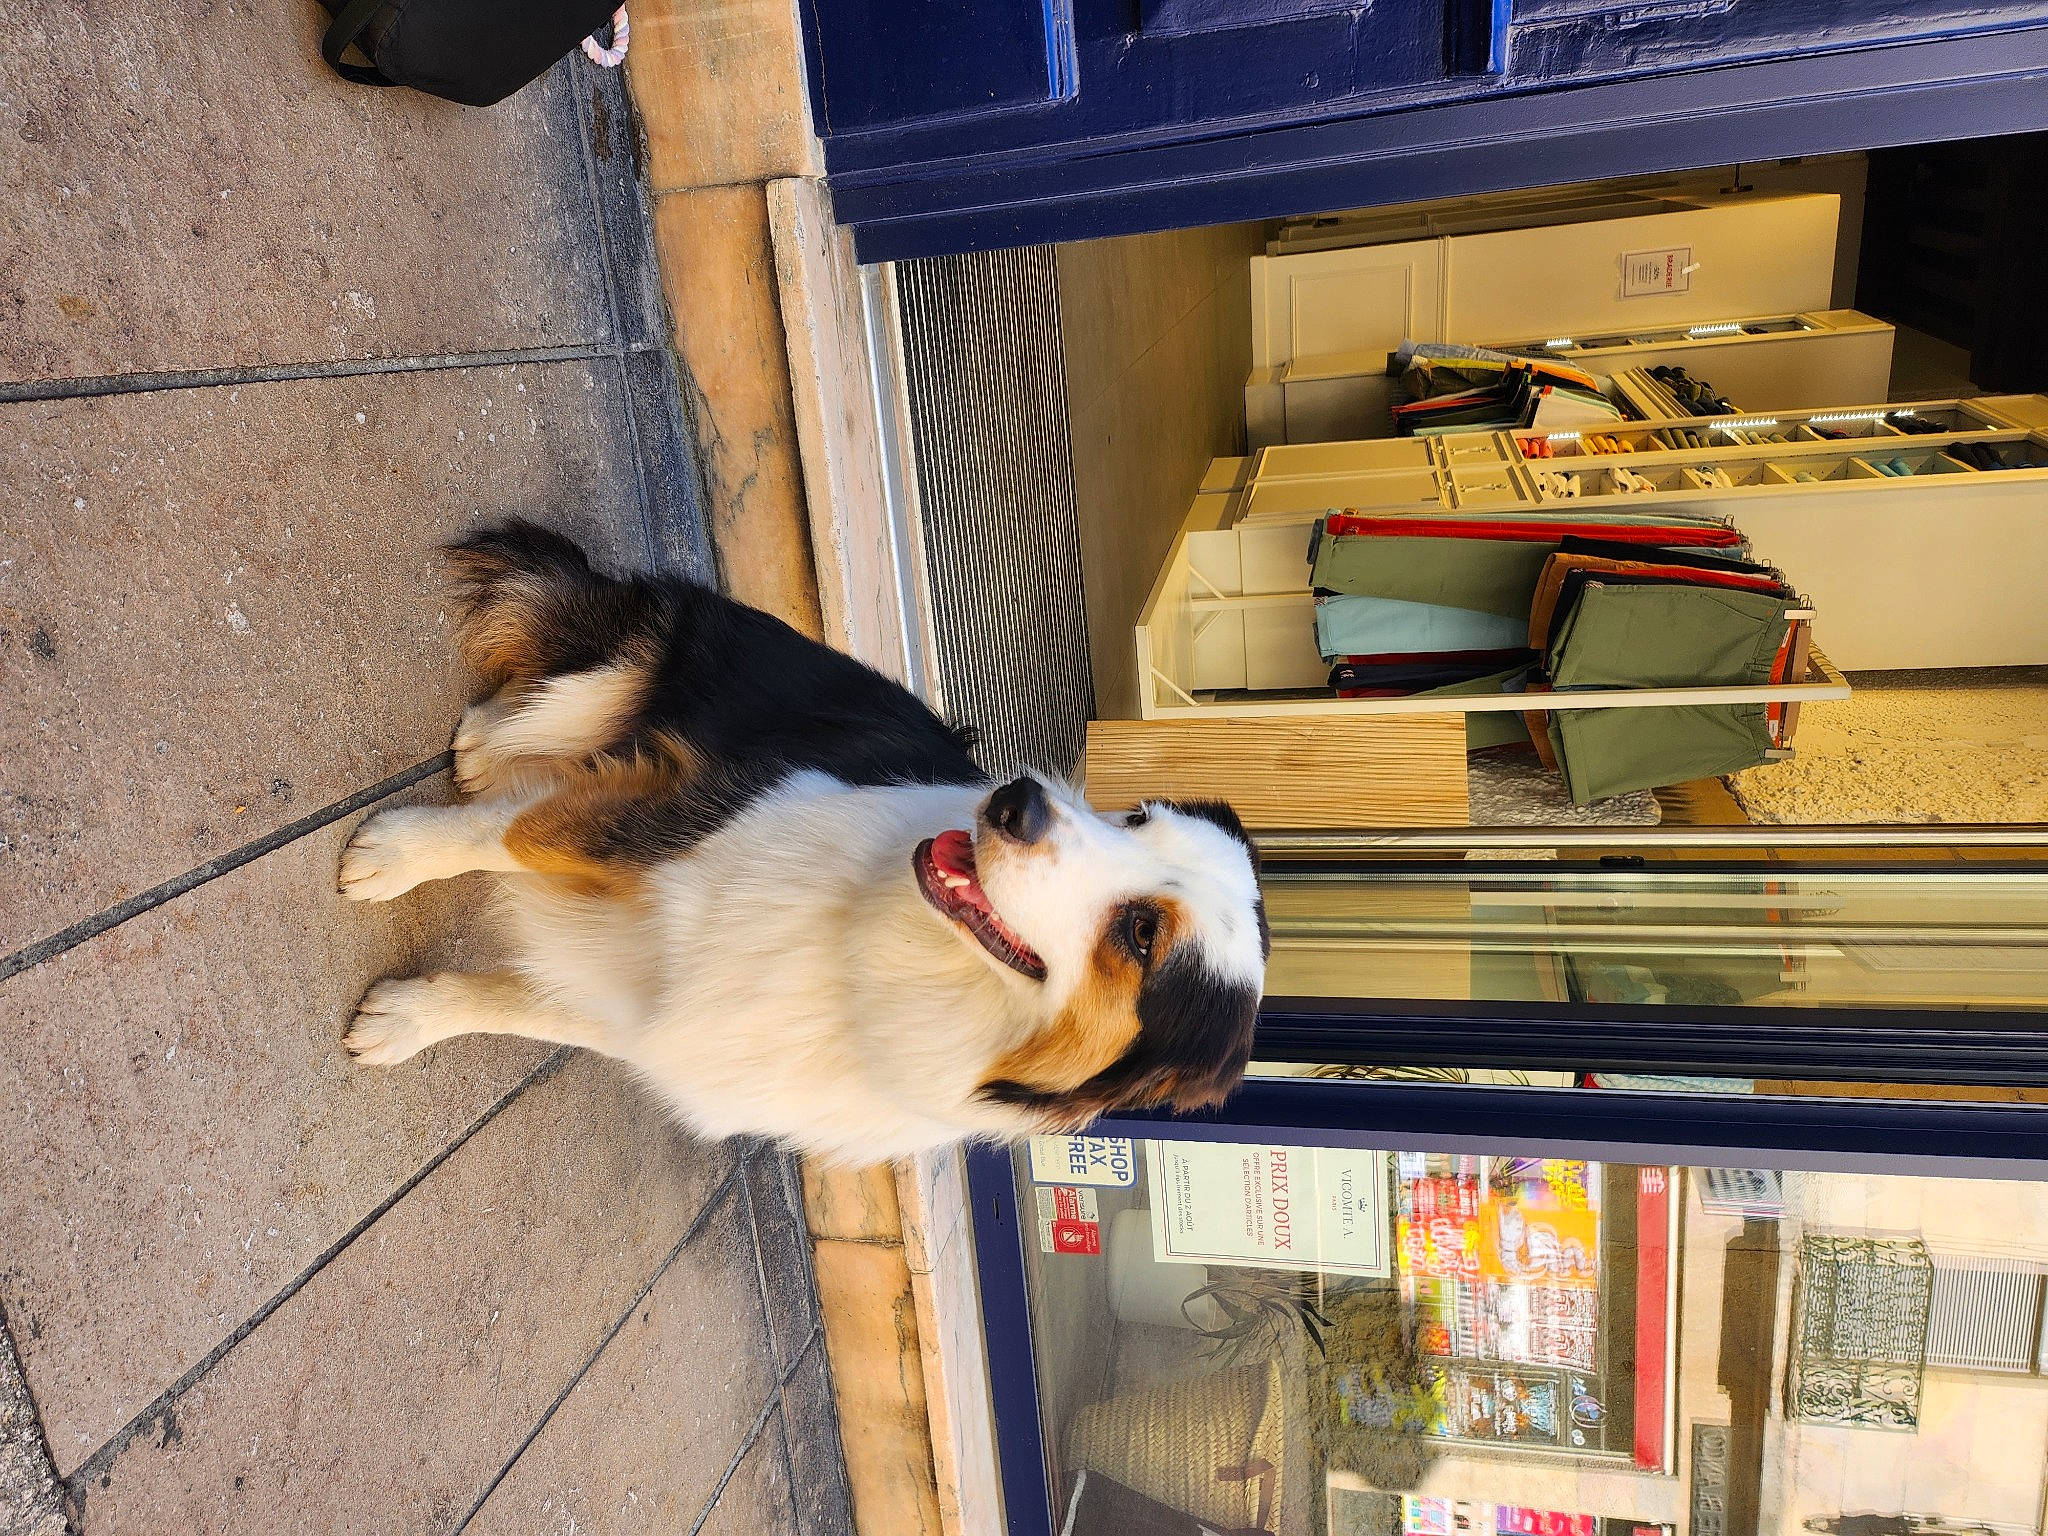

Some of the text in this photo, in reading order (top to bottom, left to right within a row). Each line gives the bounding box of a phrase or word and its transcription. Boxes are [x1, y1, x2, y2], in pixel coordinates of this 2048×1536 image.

[1109, 1138, 1128, 1182] SHOP
[1253, 1152, 1261, 1175] OFFRE
[1182, 1165, 1191, 1191] PARTIR
[1067, 1190, 1077, 1220] Alarme
[1078, 1190, 1086, 1220] verisure
[1184, 1193, 1191, 1204] DU
[1254, 1177, 1262, 1214] EXCLUSIVE
[1270, 1150, 1291, 1250] PRIX DOUX
[1342, 1169, 1354, 1239] VICOMTE A.
[1244, 1198, 1254, 1237] D'ARTICLES
[1256, 1215, 1264, 1230] SUR
